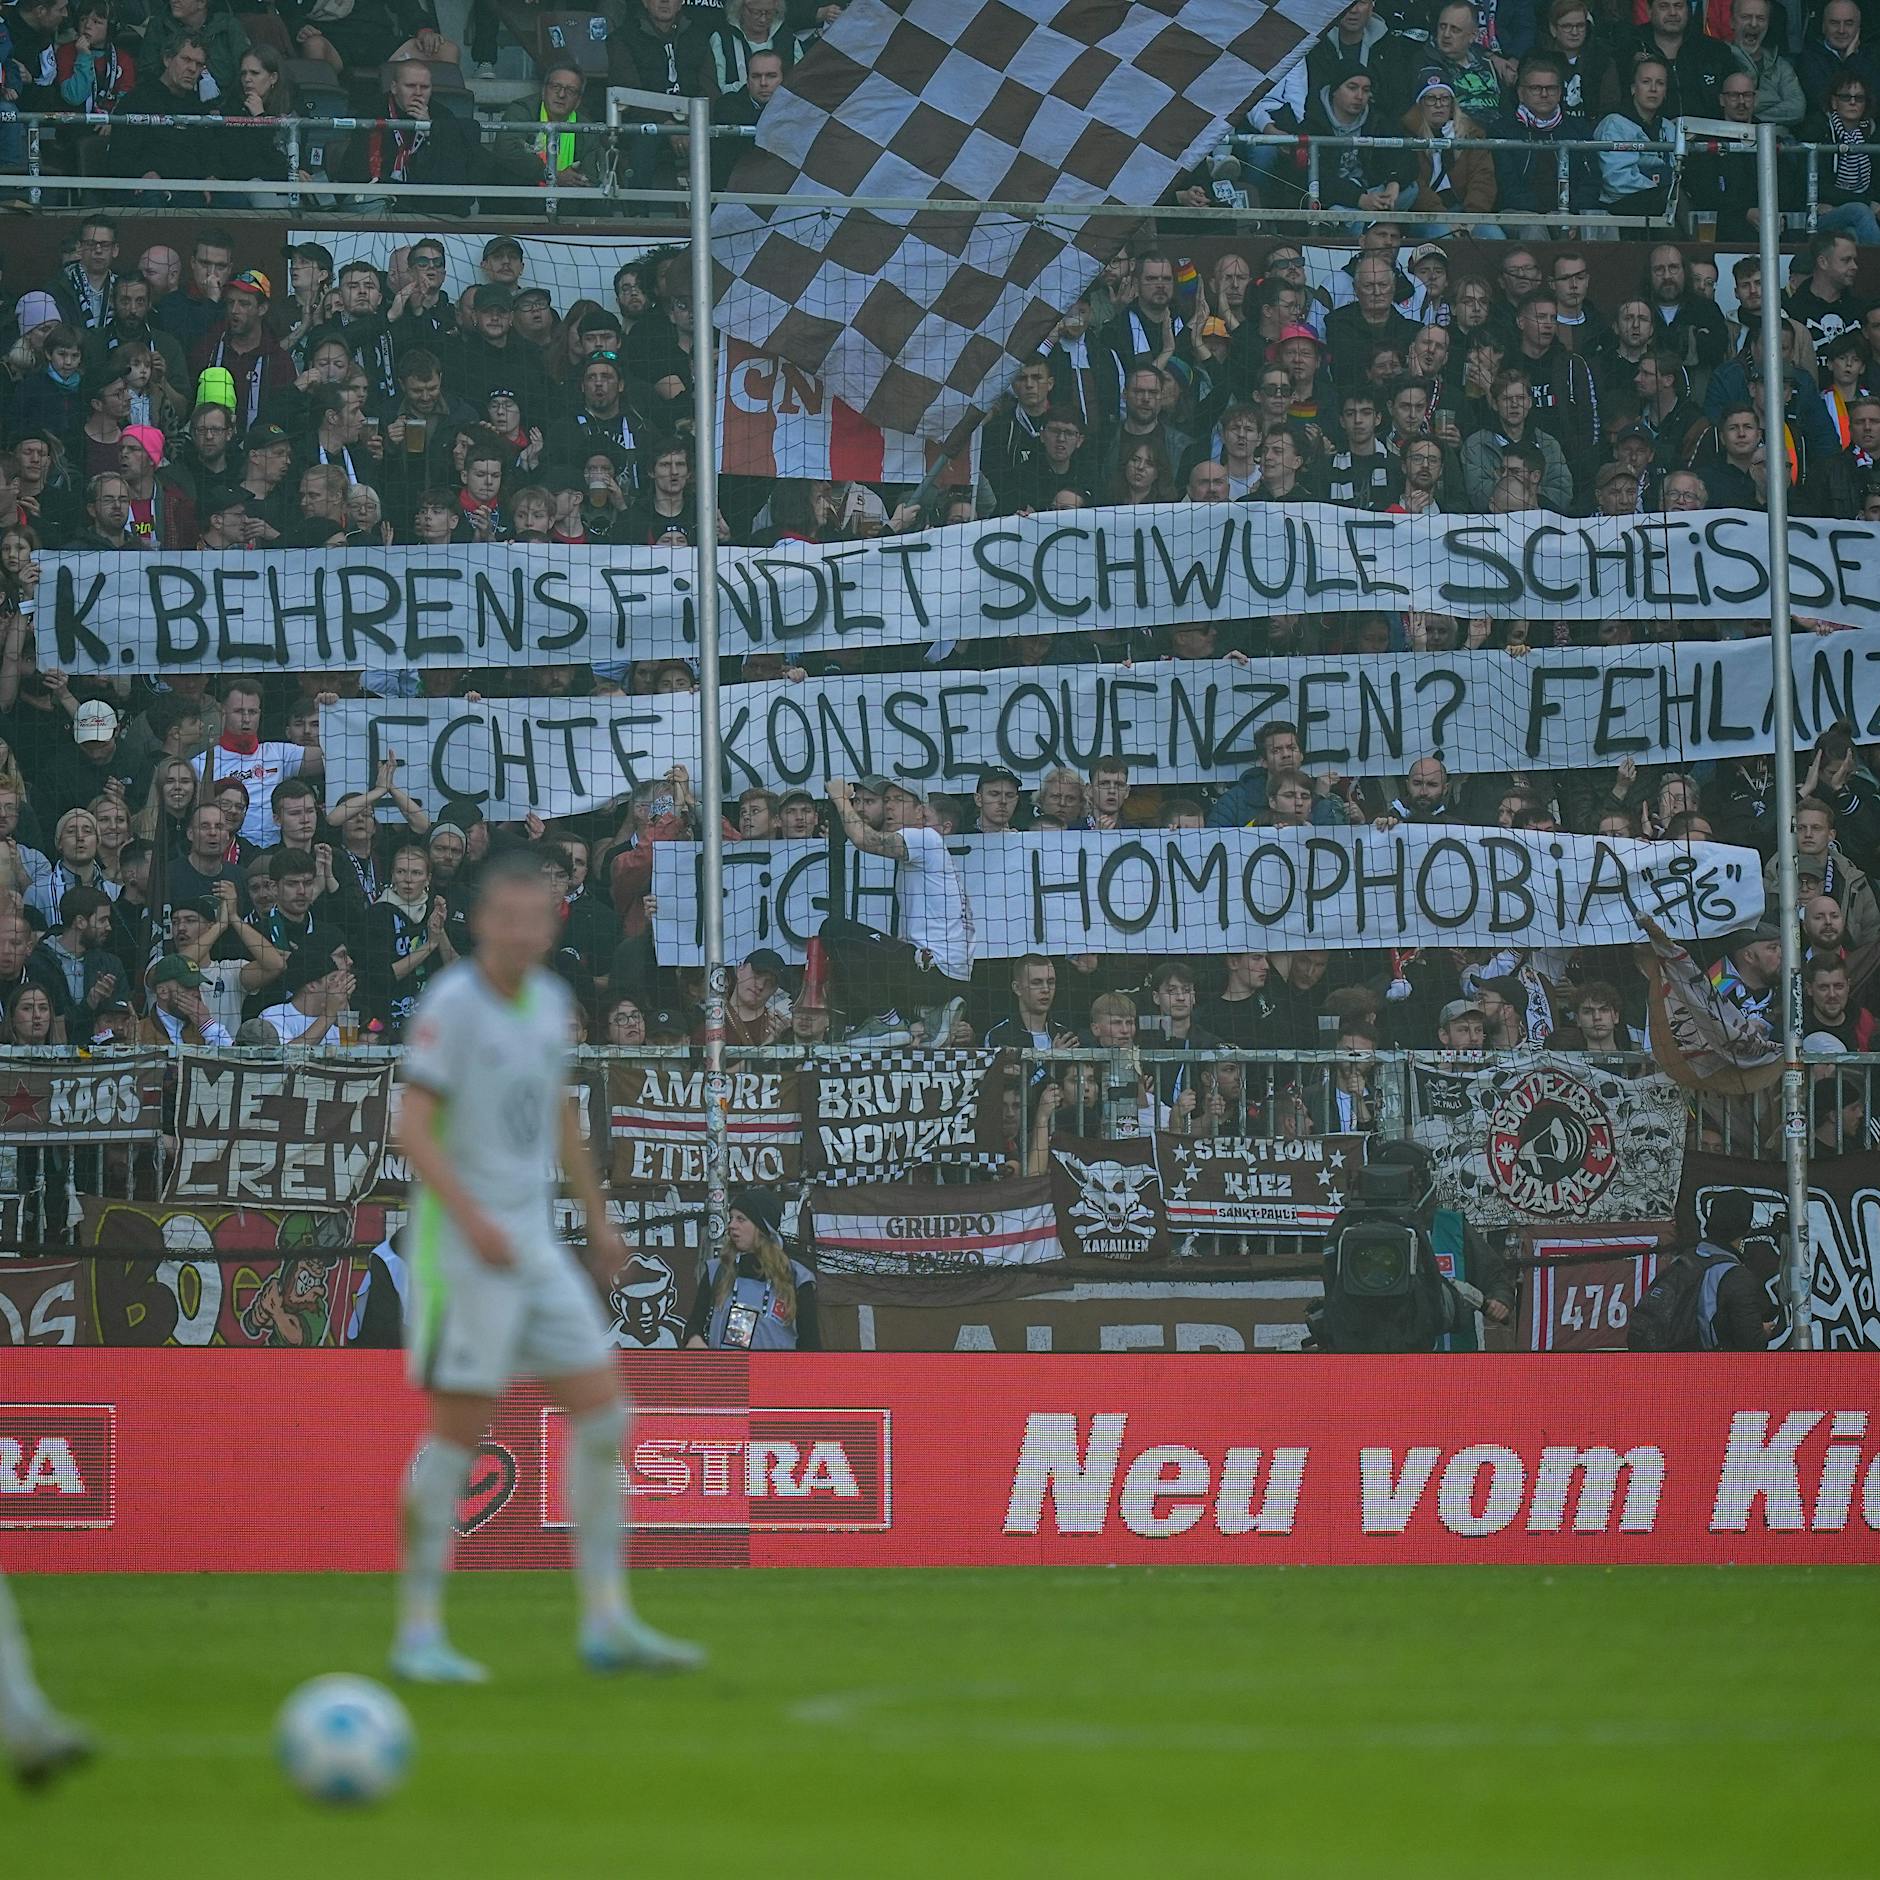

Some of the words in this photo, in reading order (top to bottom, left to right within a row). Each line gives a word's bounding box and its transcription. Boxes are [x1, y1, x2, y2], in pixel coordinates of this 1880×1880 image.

[972, 517, 1410, 621] SCHWULE
[719, 667, 1467, 794] KONSEQUENZEN?
[1526, 647, 1880, 758] FEHLAN
[694, 844, 971, 948] FiGH
[49, 1074, 141, 1127] KAOS
[185, 1066, 382, 1136] METT
[817, 1069, 988, 1119] BRUTTE
[818, 1104, 976, 1166] NOTIZIE
[175, 1137, 379, 1202] CREW
[886, 1213, 996, 1240] GRUPPO
[1560, 1283, 1628, 1331] 476
[1002, 1411, 1310, 1537] Neu
[1358, 1443, 1666, 1537] vom
